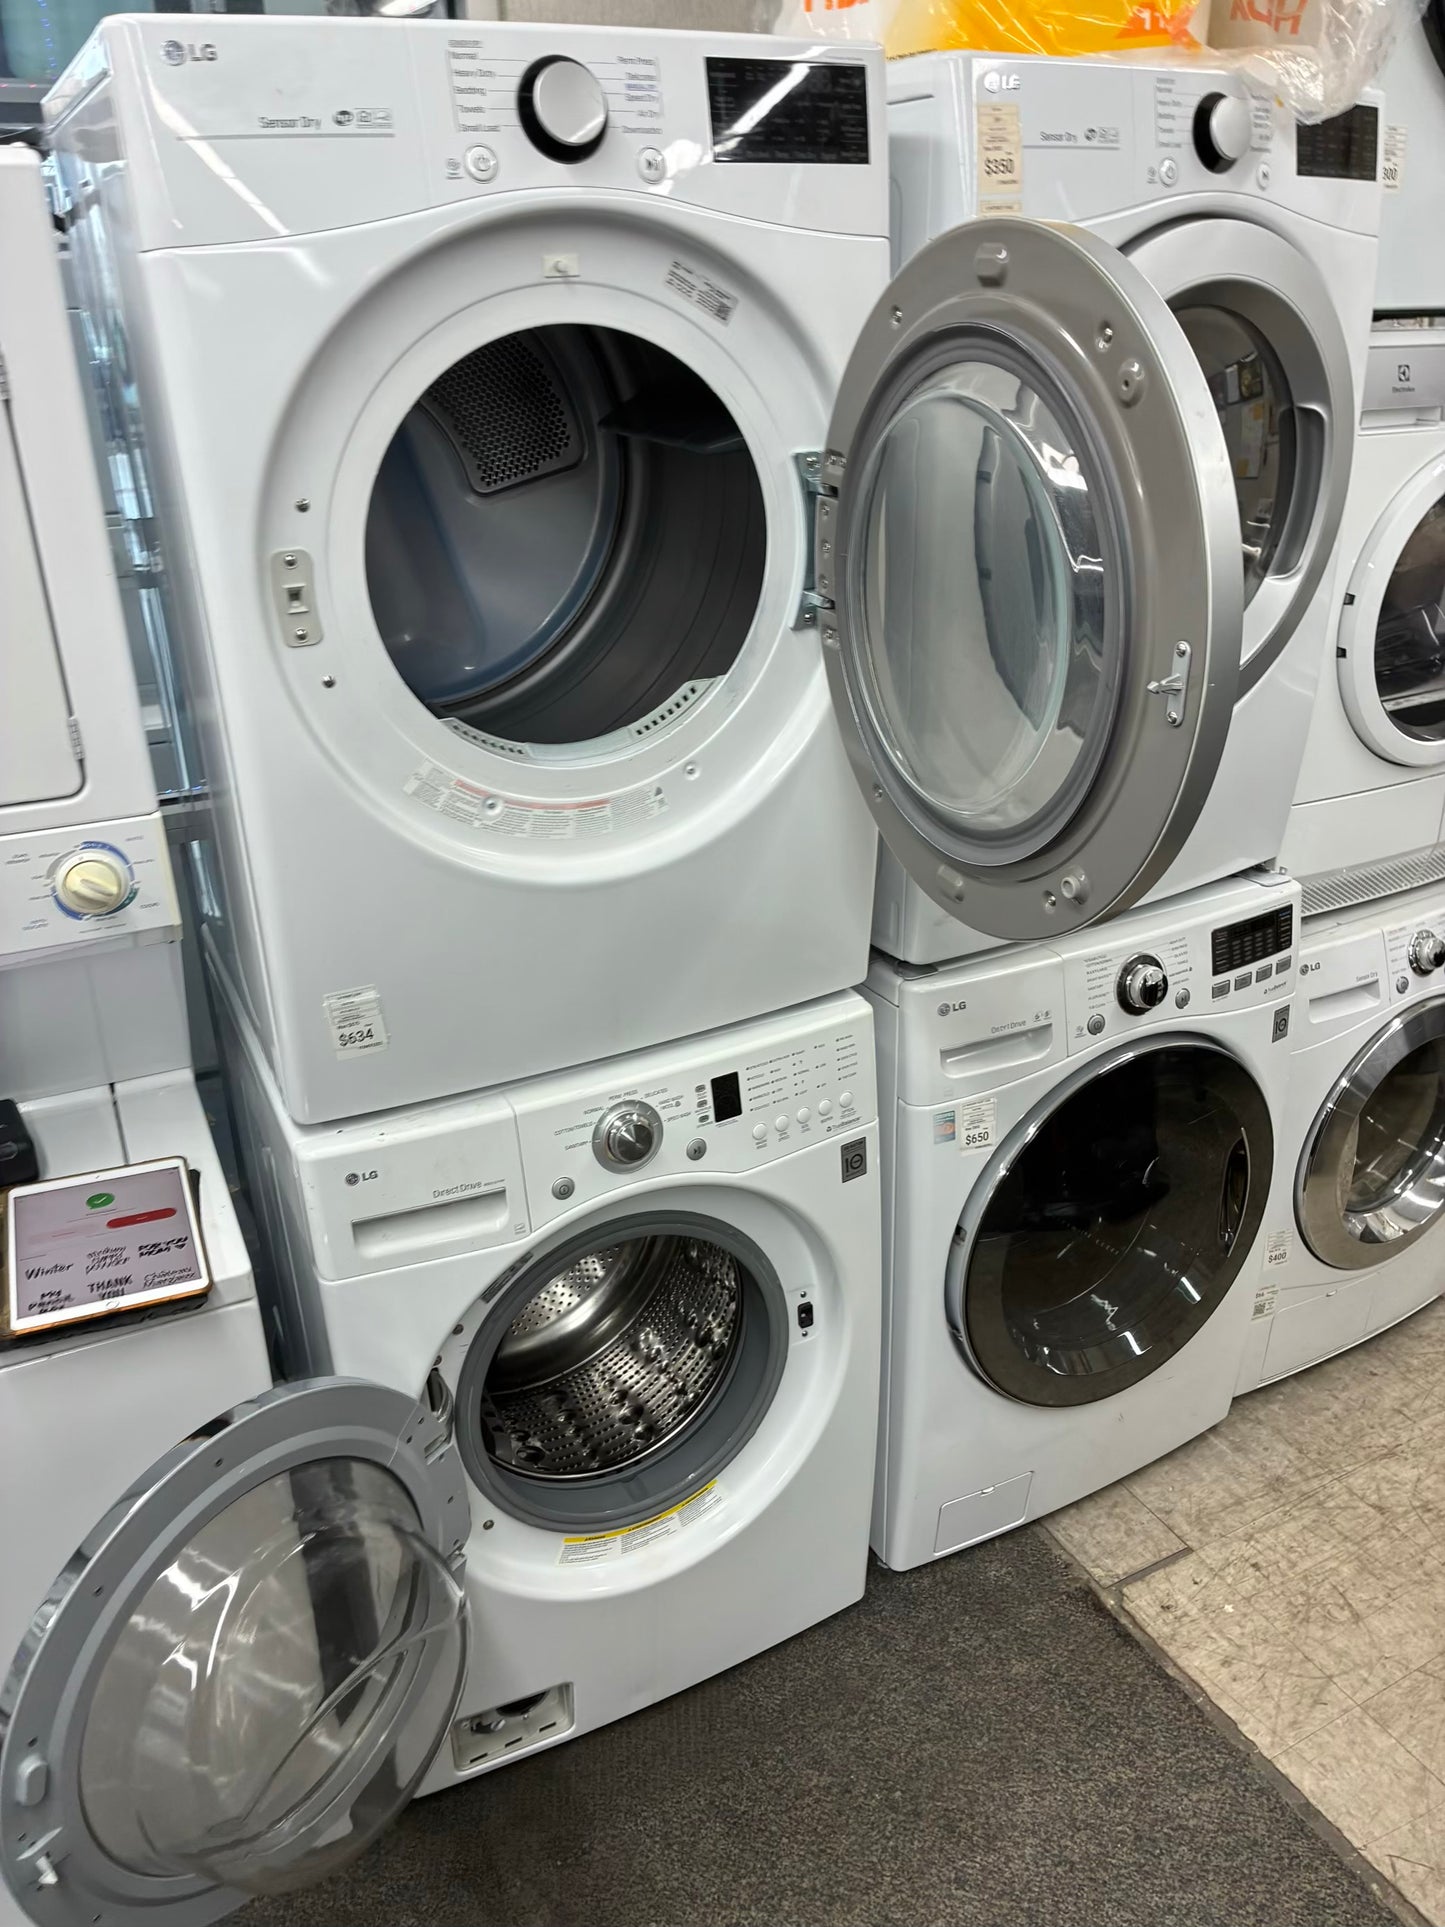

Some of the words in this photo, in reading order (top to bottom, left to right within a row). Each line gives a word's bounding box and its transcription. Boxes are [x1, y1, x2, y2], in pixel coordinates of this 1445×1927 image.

[187, 43, 217, 61] LG
[984, 157, 1015, 177] $350
[1310, 962, 1321, 972] LG
[952, 1001, 967, 1012] LG
[339, 1028, 374, 1047] $634
[965, 1131, 990, 1146] $650
[362, 1170, 379, 1182] LG
[432, 1186, 459, 1198] Direct
[459, 1181, 483, 1192] Drive
[1268, 1252, 1287, 1264] $400
[25, 1262, 75, 1281] Winter
[87, 1275, 133, 1293] THANK
